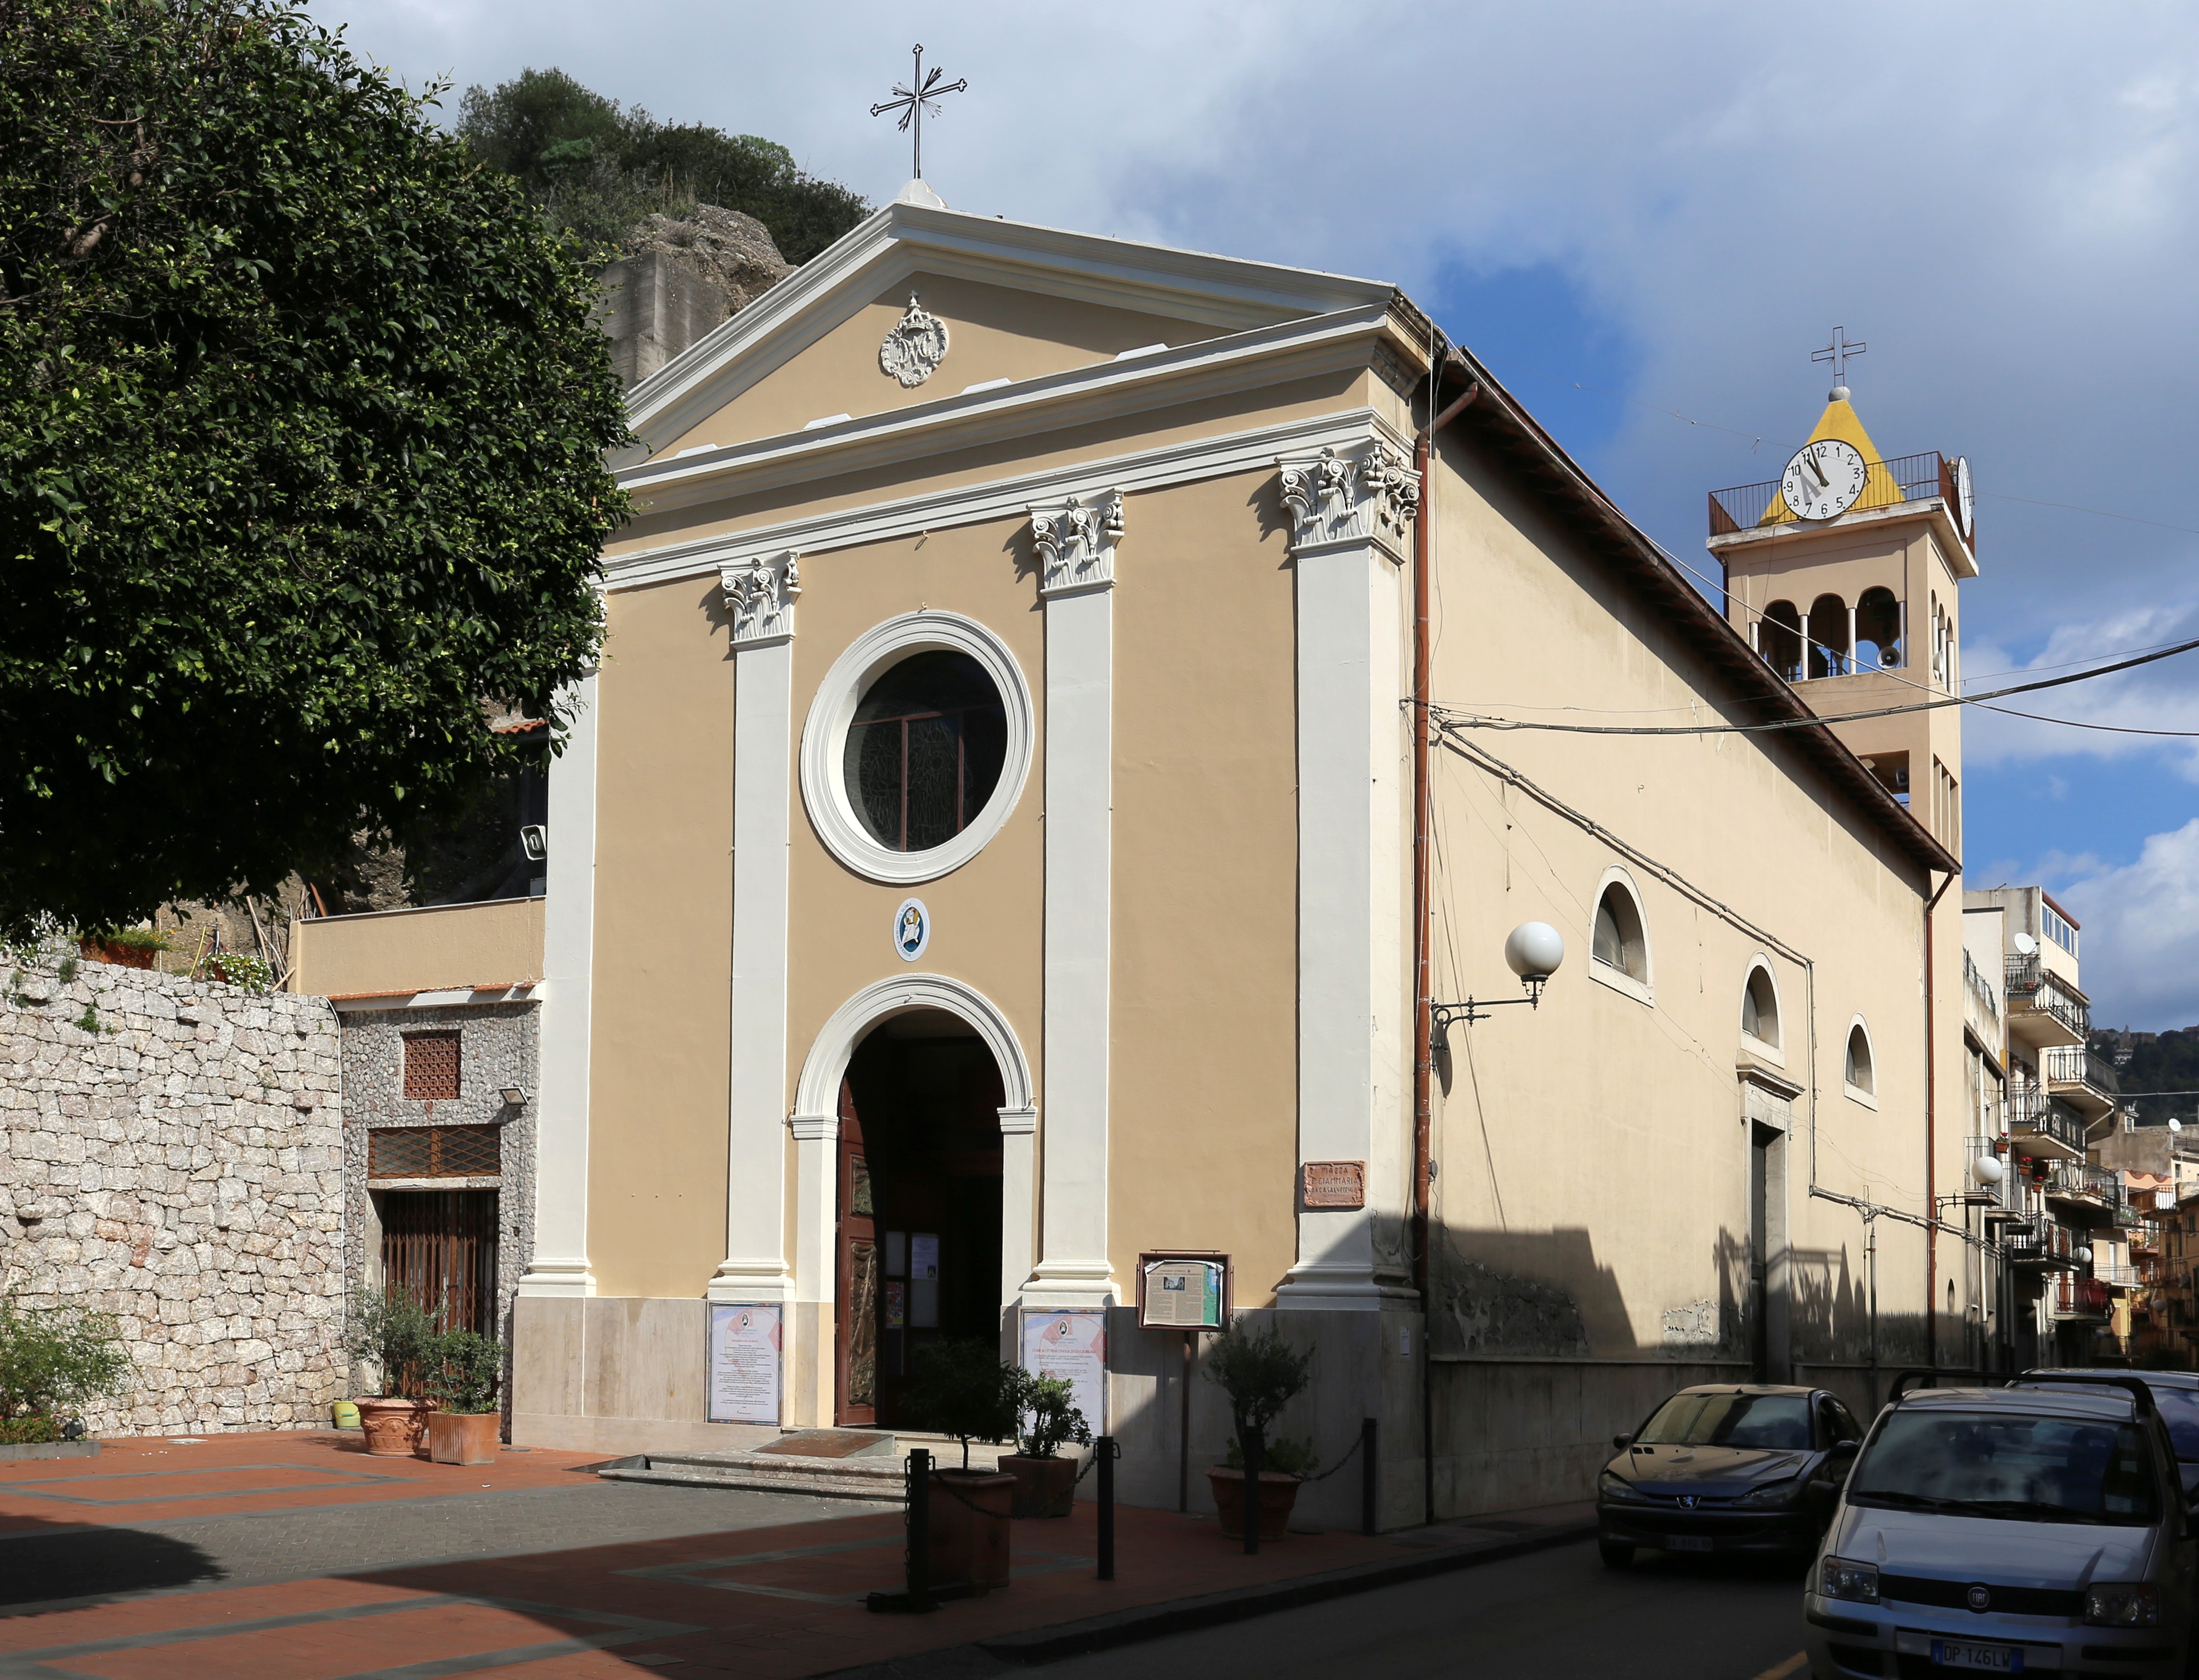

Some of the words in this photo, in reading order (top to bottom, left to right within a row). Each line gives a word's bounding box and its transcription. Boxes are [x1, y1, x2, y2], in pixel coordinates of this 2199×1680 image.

[1816, 445, 1828, 458] 12
[1836, 446, 1840, 457] 1
[1802, 452, 1811, 465] 11
[1847, 454, 1854, 465] 2
[1790, 464, 1801, 477] 10
[1853, 467, 1860, 479] 3
[1787, 481, 1793, 492] 9
[1848, 484, 1855, 495] 4
[1793, 495, 1799, 507] 8
[1836, 496, 1843, 508] 5
[1805, 502, 1812, 514] 7
[1821, 503, 1828, 514] 6
[1972, 1592, 1986, 1603] FIAT
[1944, 1645, 1960, 1661] DP
[1967, 1648, 2010, 1668] 146LW
